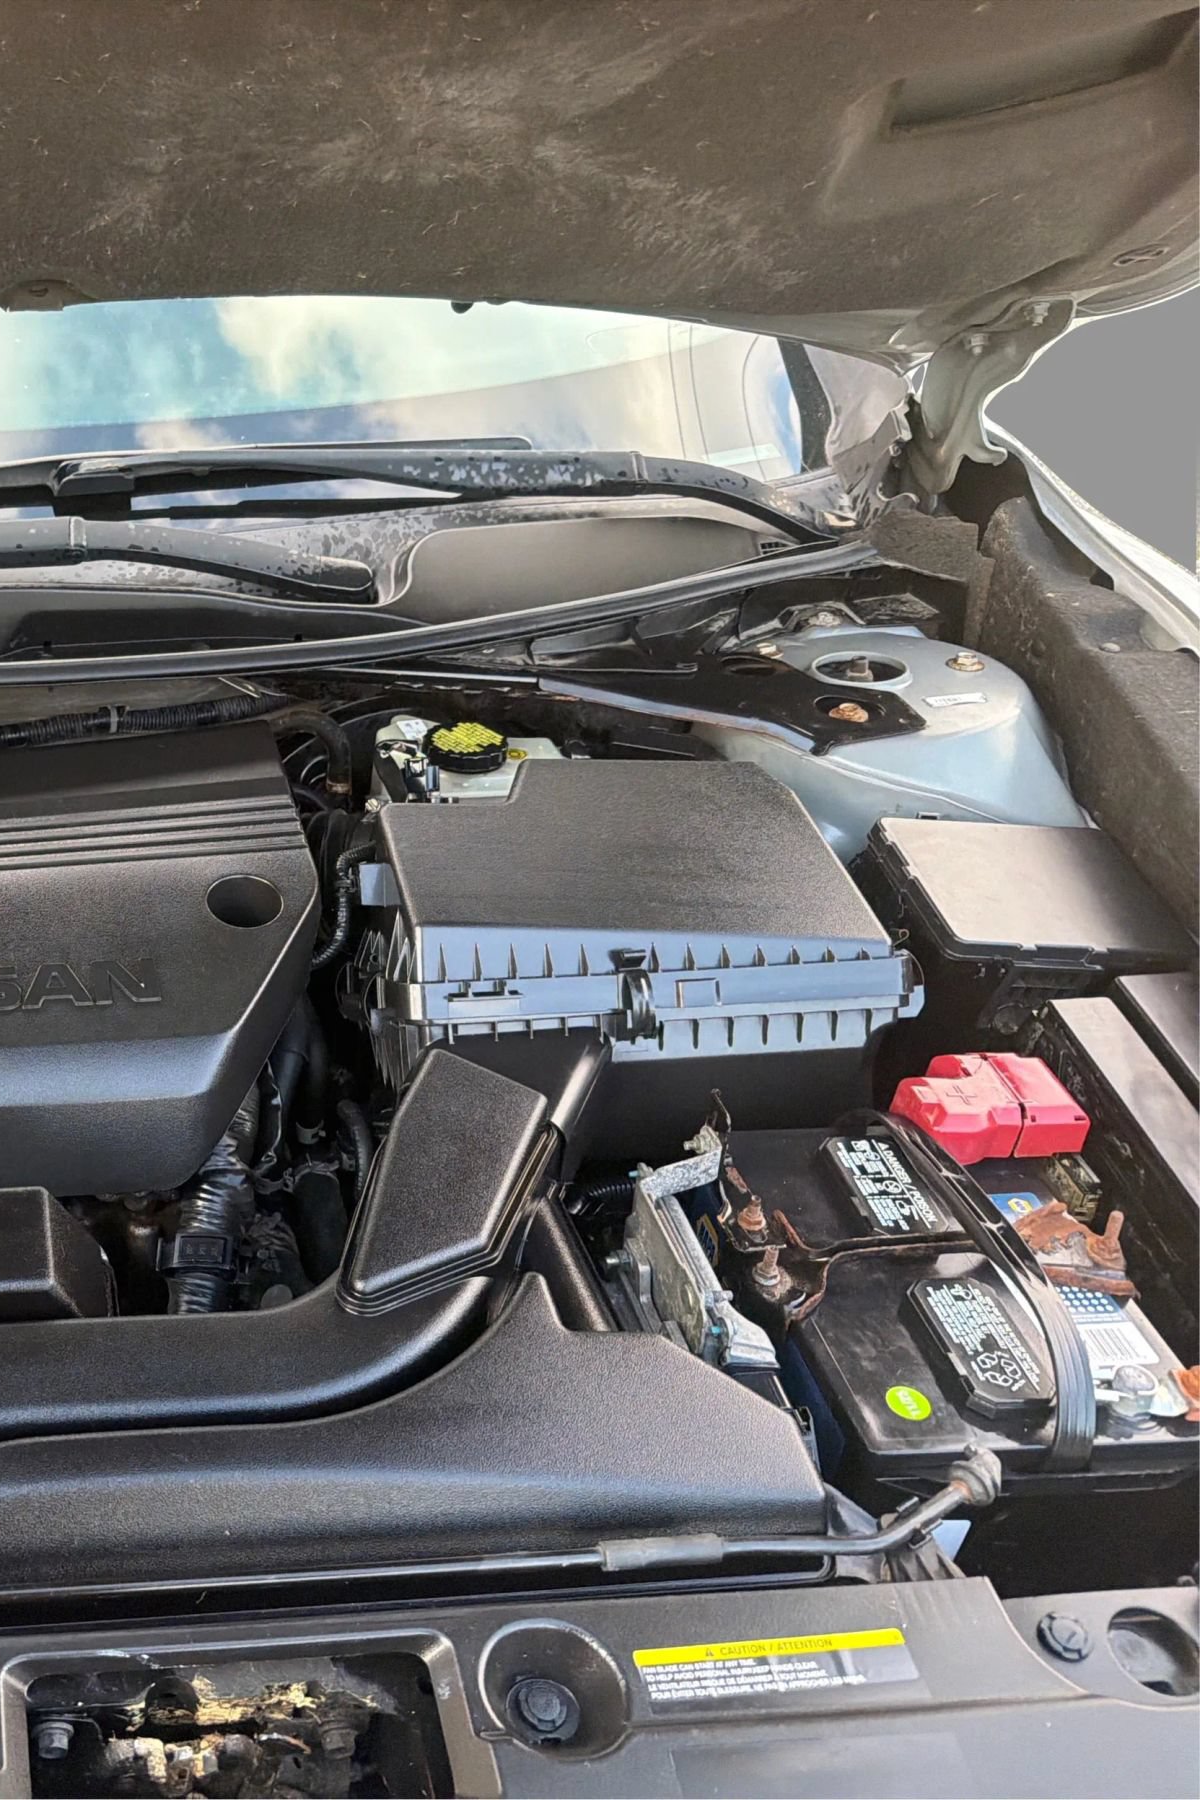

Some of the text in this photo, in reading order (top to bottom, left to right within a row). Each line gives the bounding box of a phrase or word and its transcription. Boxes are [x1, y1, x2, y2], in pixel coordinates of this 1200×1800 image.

[882, 1150, 912, 1184] DANGER
[909, 1190, 938, 1222] POISON
[720, 1643, 765, 1656] CAUTION
[777, 1639, 833, 1652] ATTENTION
